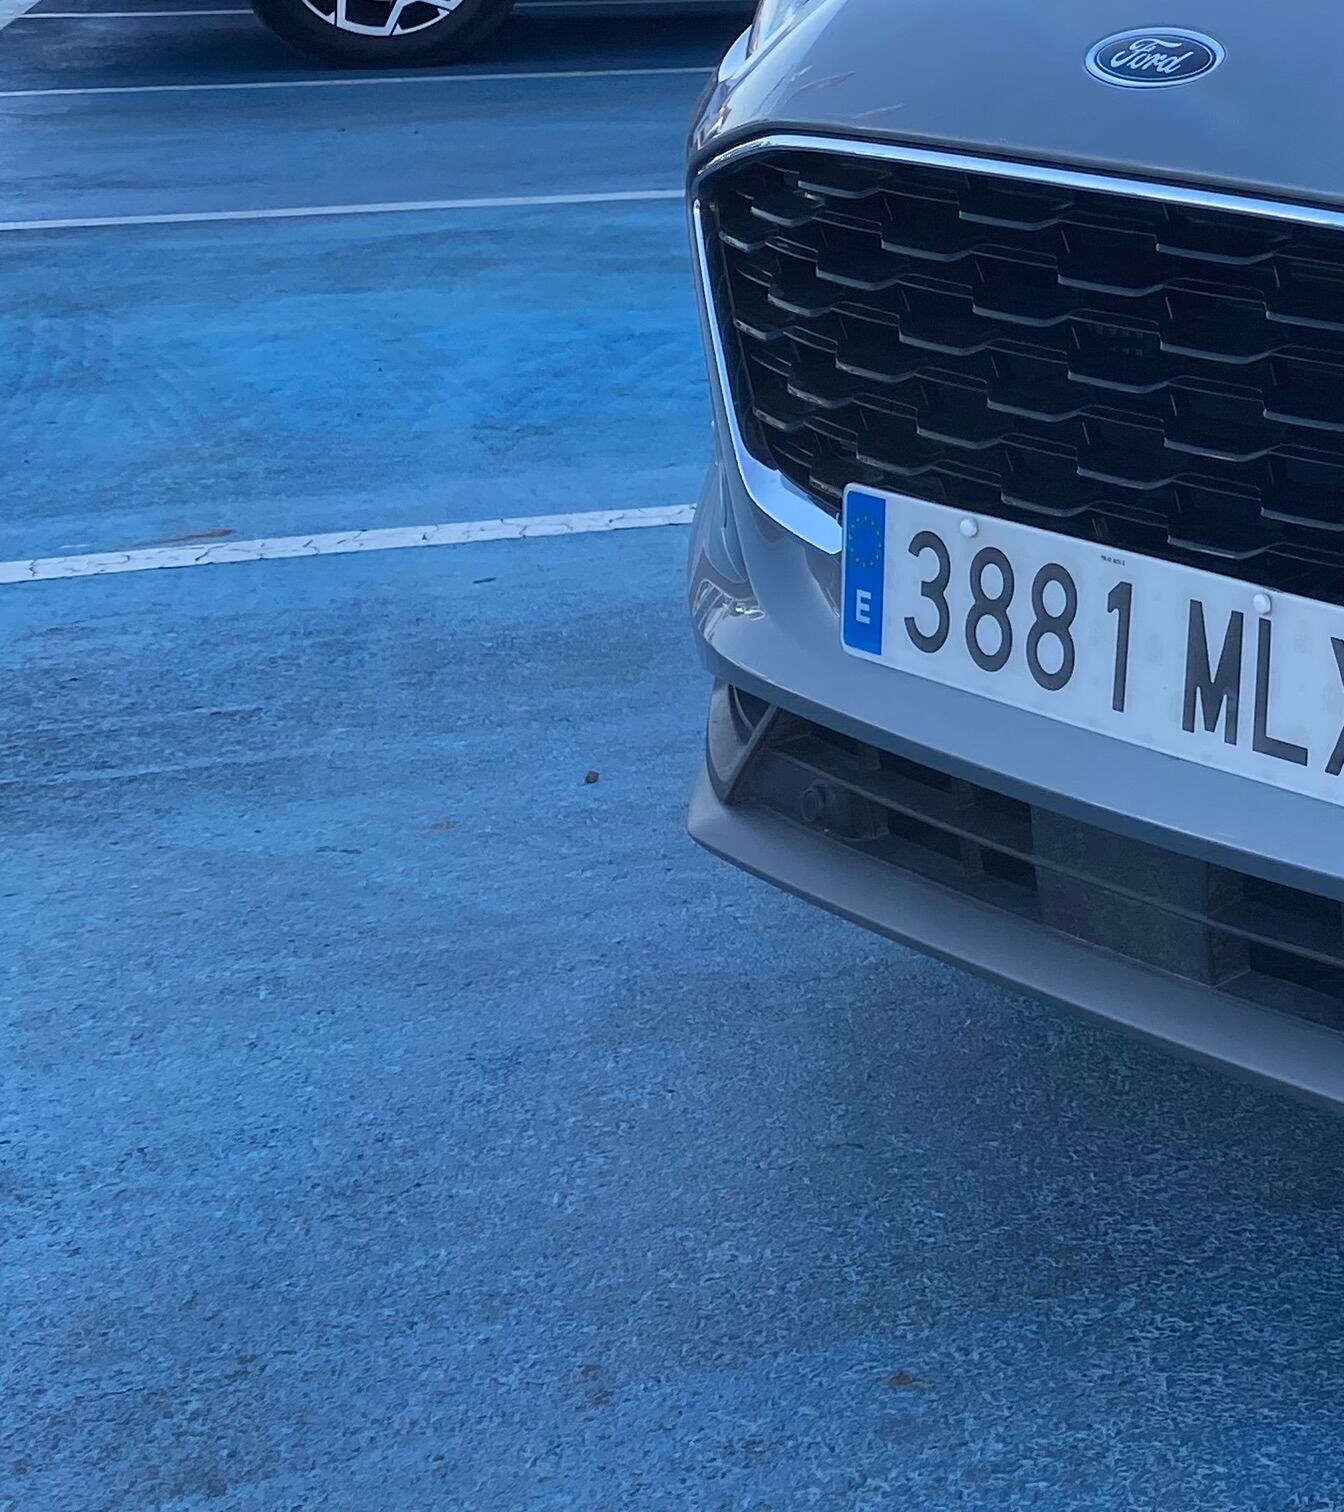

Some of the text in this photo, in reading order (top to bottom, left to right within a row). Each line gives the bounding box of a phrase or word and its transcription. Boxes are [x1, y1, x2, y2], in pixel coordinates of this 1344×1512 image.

[1110, 38, 1194, 74] Ford
[855, 590, 871, 624] E
[904, 530, 1133, 713] 3881
